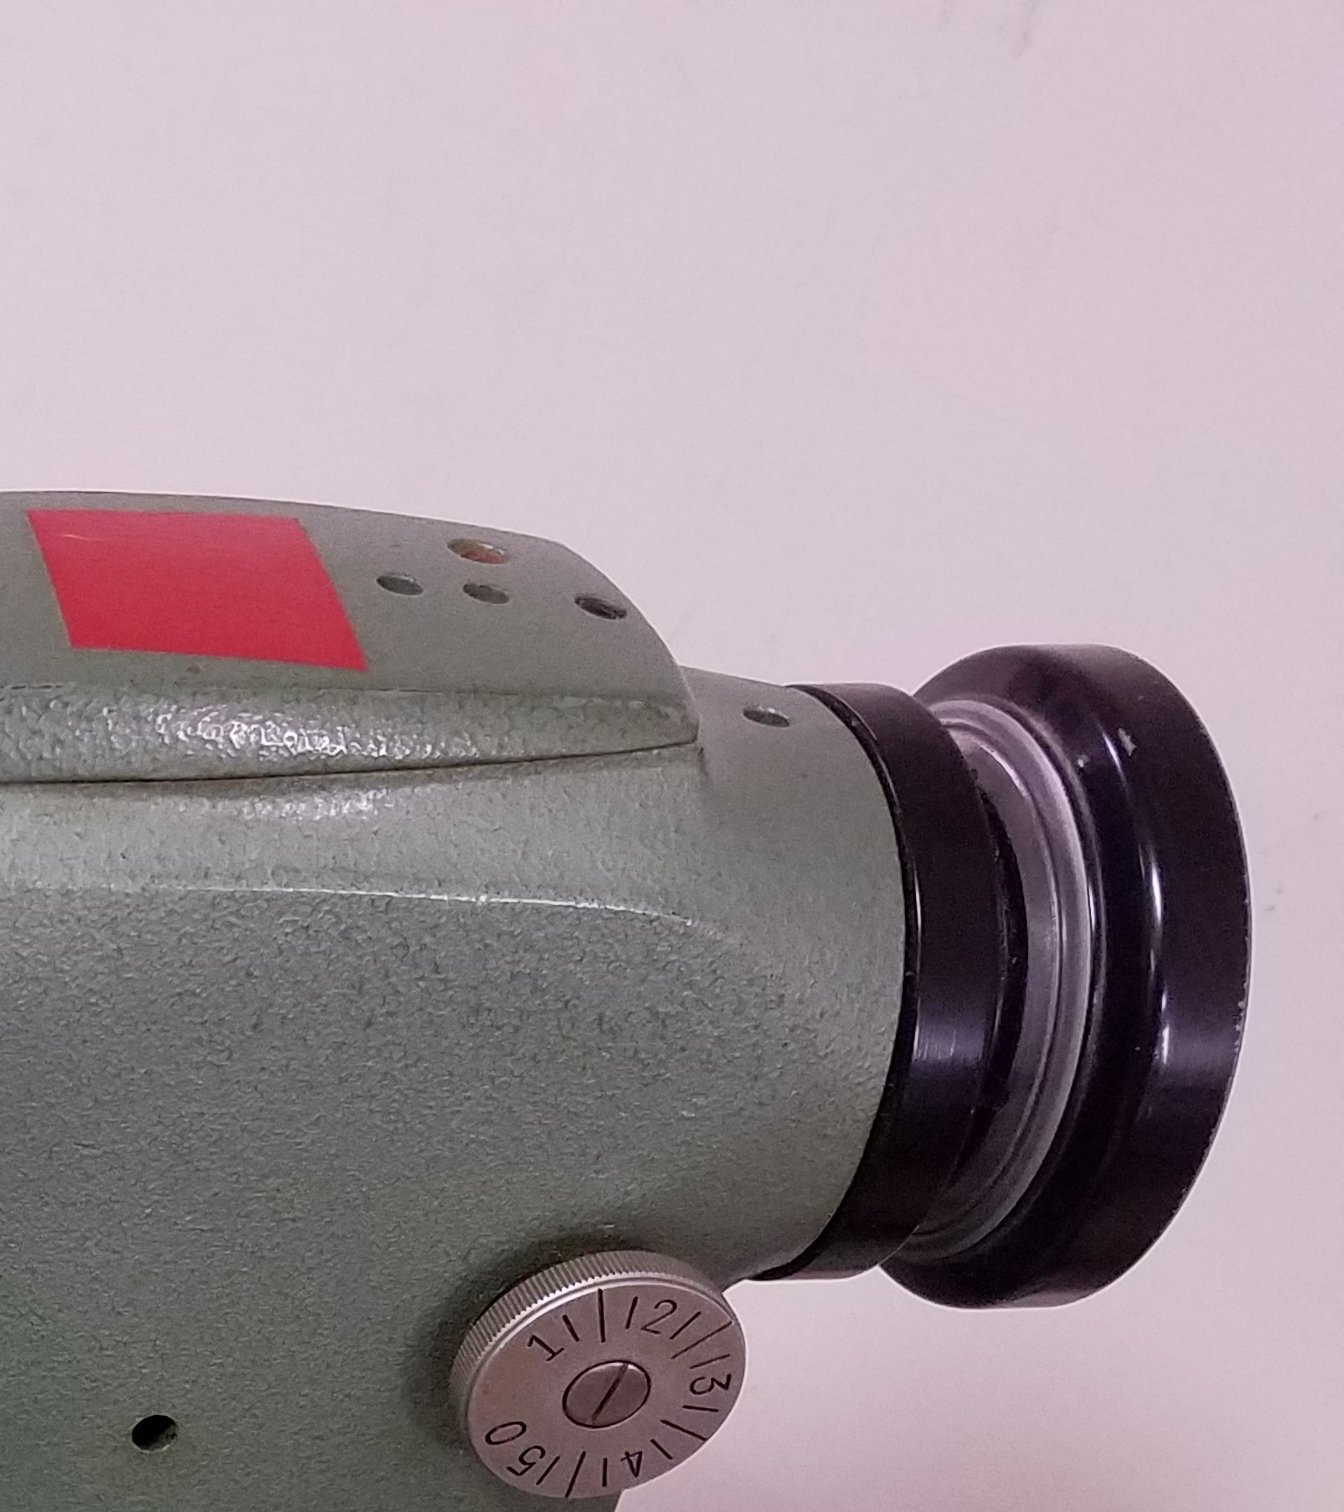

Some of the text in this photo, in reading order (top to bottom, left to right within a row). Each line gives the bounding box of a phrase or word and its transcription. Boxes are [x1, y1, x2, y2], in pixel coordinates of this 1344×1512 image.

[640, 1299, 677, 1334] 2
[527, 1334, 564, 1362] 1
[689, 1373, 732, 1395] 3
[485, 1421, 527, 1445] 0
[507, 1445, 546, 1476] 5
[620, 1451, 643, 1478] 4
